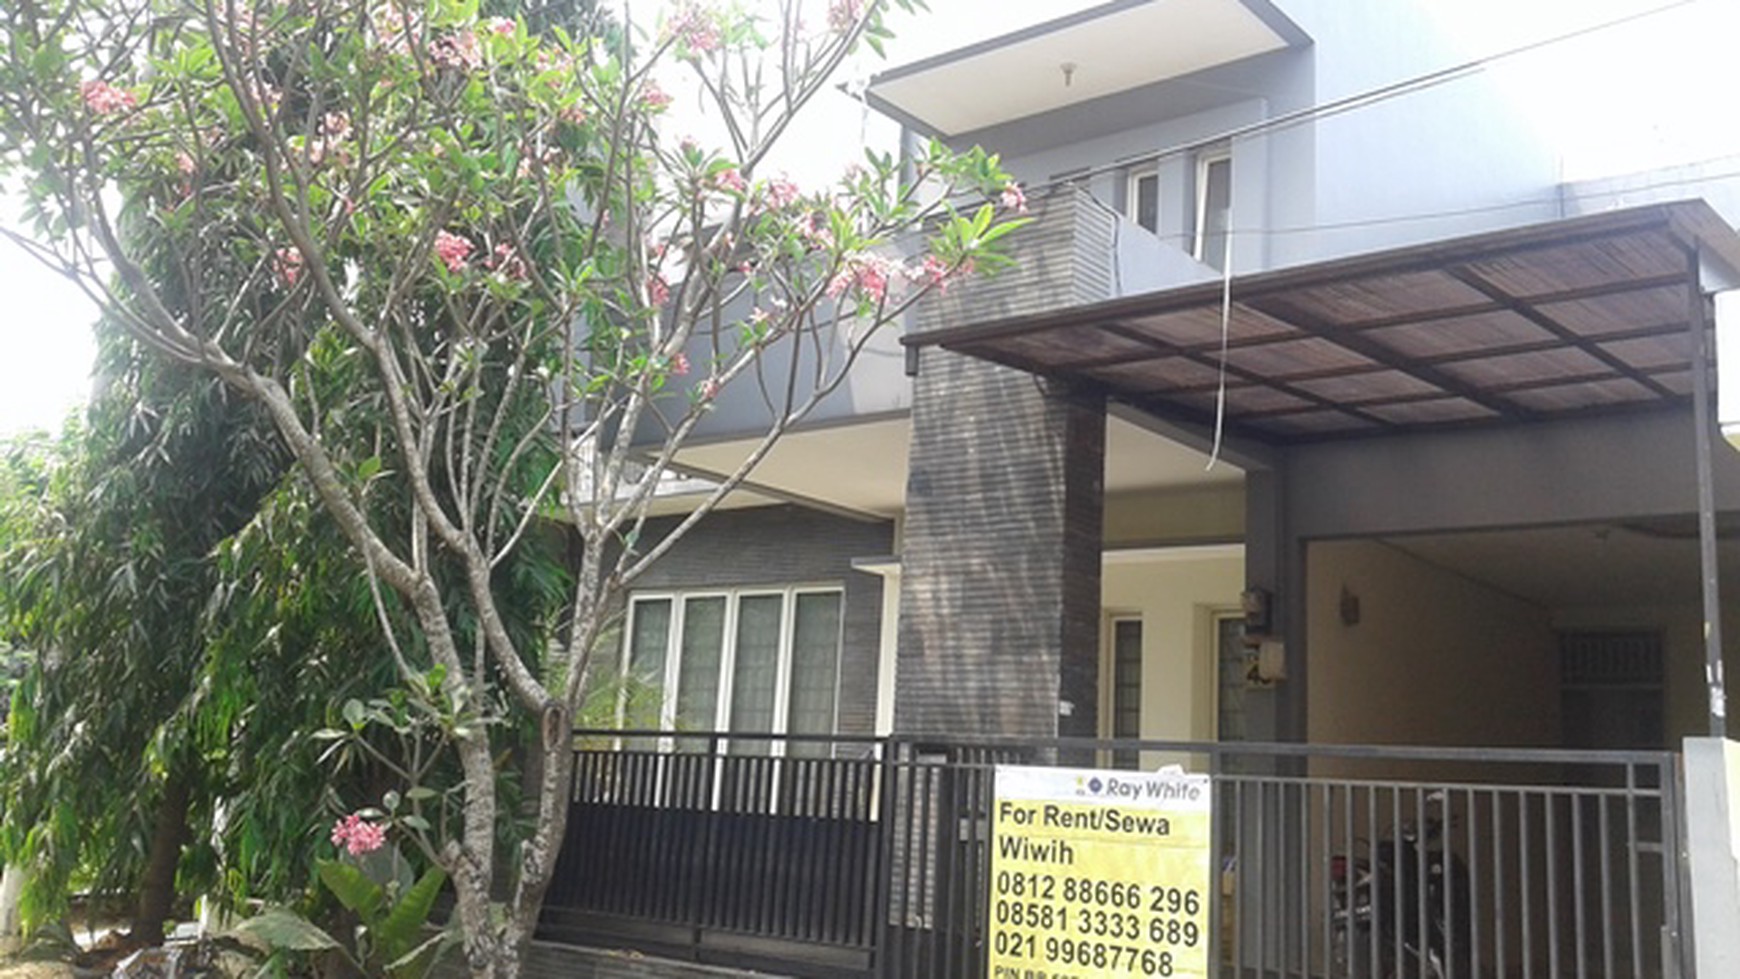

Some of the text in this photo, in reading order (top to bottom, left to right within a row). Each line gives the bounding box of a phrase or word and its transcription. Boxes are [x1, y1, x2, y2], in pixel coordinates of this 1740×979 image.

[1106, 778, 1142, 800] Ray
[1146, 781, 1201, 801] White
[999, 802, 1170, 835] For Rent/Sewa
[999, 835, 1074, 864] Wiwih
[997, 870, 1200, 915] 0812 88666 296
[996, 900, 1199, 947] 08581 3333 689
[995, 931, 1173, 977] 021 99687768
